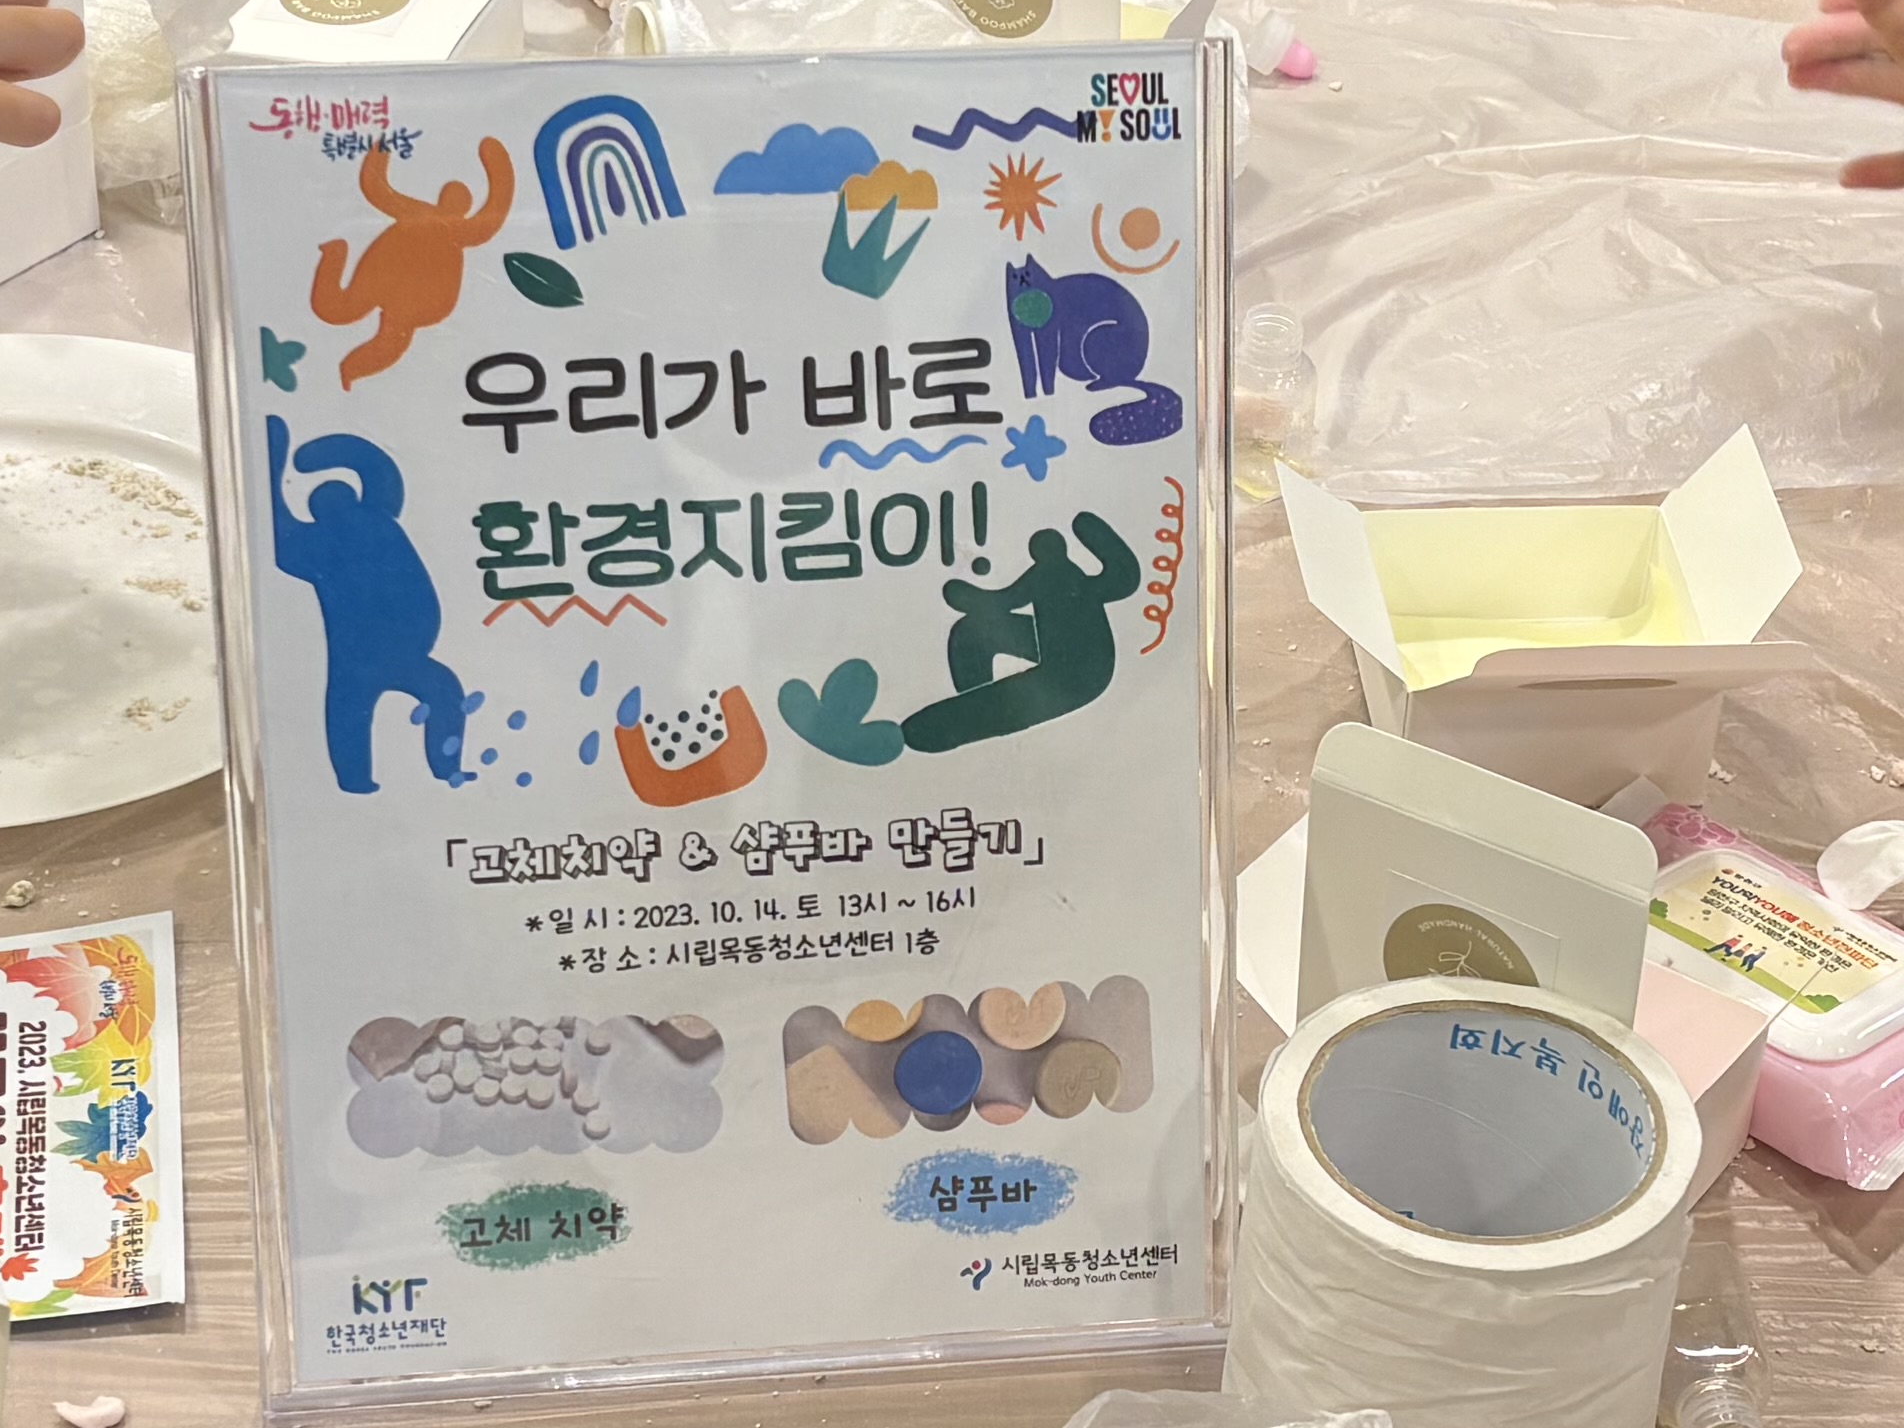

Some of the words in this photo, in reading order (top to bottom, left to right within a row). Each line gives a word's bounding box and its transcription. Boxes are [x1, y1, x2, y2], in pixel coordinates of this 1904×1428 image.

[462, 350, 767, 454] 우리가
[802, 337, 1004, 431] 바로
[471, 480, 992, 602] 환경지킴이!
[679, 831, 719, 872] &
[731, 820, 873, 876] 샴푸바
[634, 903, 700, 929] 2023.
[711, 900, 743, 924] 10.
[754, 897, 787, 921] 14.
[796, 894, 822, 919] 토
[838, 891, 886, 917] 13시
[926, 886, 975, 913] 16시
[666, 930, 893, 967] 시립목동청소년센터
[905, 927, 940, 956] 1층
[16, 1021, 47, 1074] 2023.
[1449, 1024, 1566, 1076] 복지회
[14, 1080, 47, 1254] 시립목동청소년센터
[929, 1175, 1038, 1213] 샴푸바
[459, 1215, 532, 1249] 고체
[549, 1202, 626, 1242] 치약
[1001, 1244, 1178, 1275] 시립목동청소년센터
[1024, 1276, 1080, 1289] Mok-dong
[1084, 1271, 1117, 1285] Youth
[1119, 1269, 1157, 1282] Center
[326, 1317, 448, 1349] 한국청소년재단
